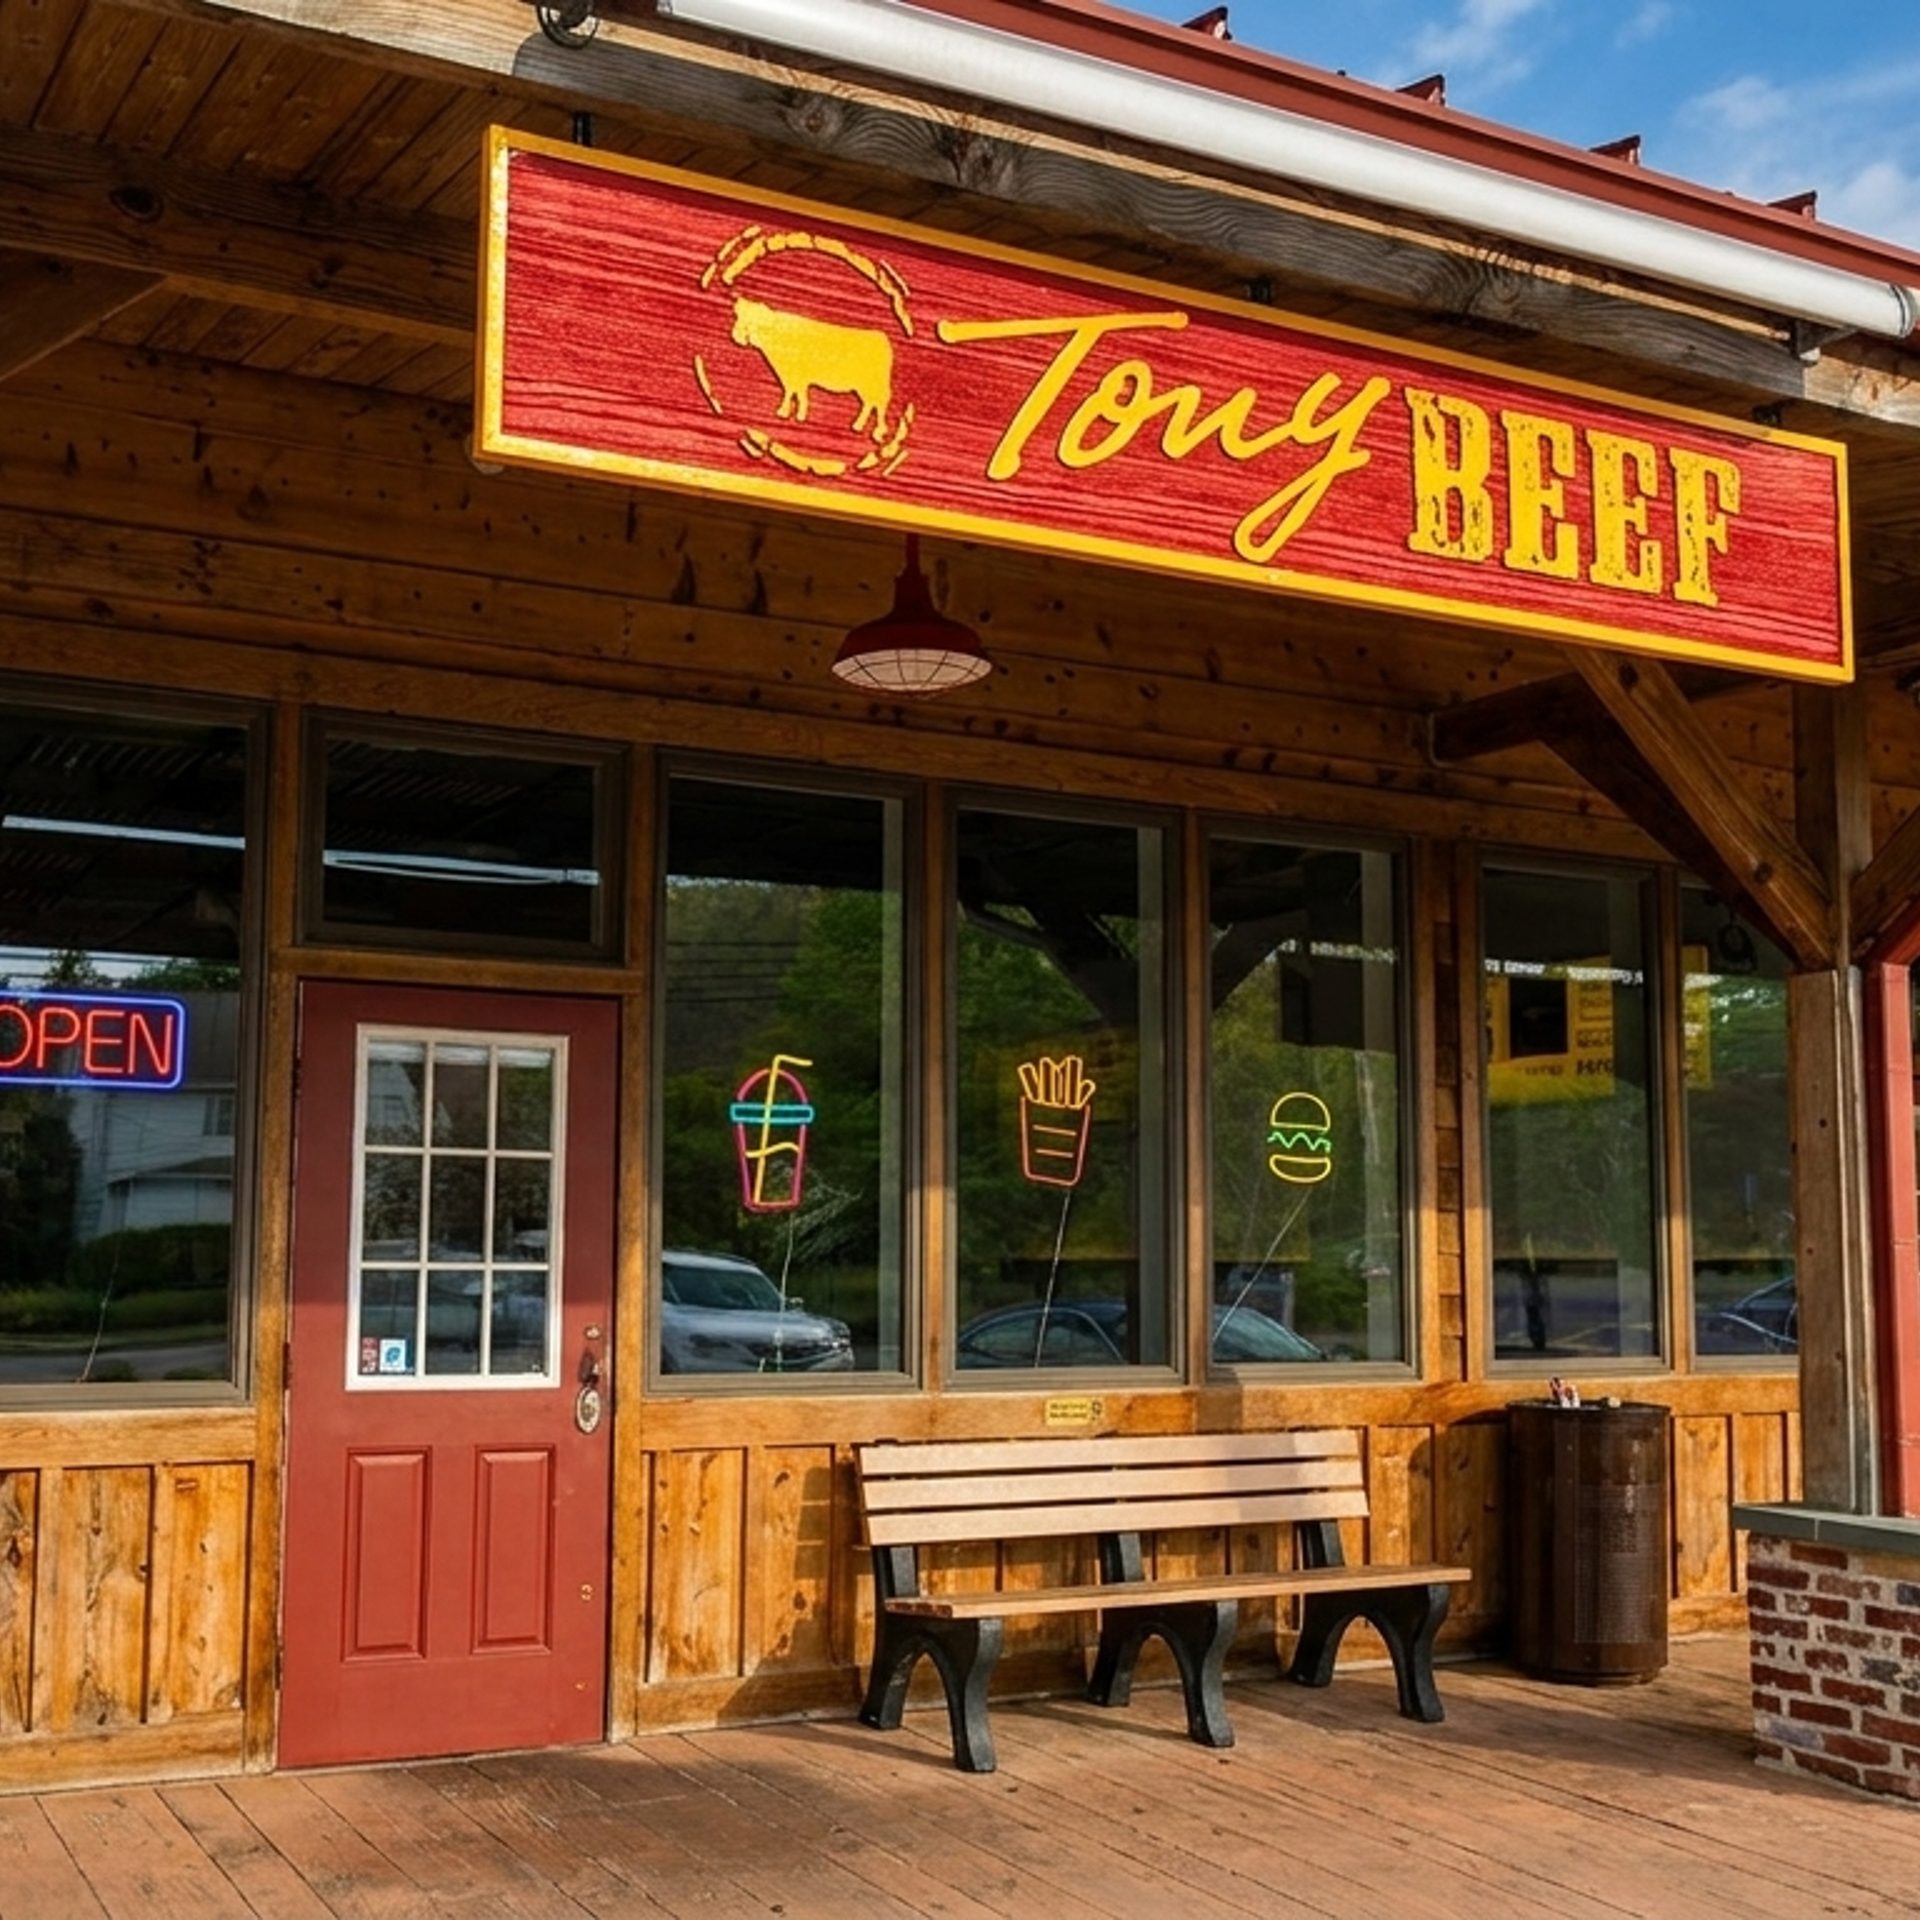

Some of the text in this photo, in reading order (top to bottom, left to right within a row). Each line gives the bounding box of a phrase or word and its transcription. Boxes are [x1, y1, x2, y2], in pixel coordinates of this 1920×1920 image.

[937, 310, 1742, 608] Tony BEEF
[0, 1003, 174, 1075] OPEN
